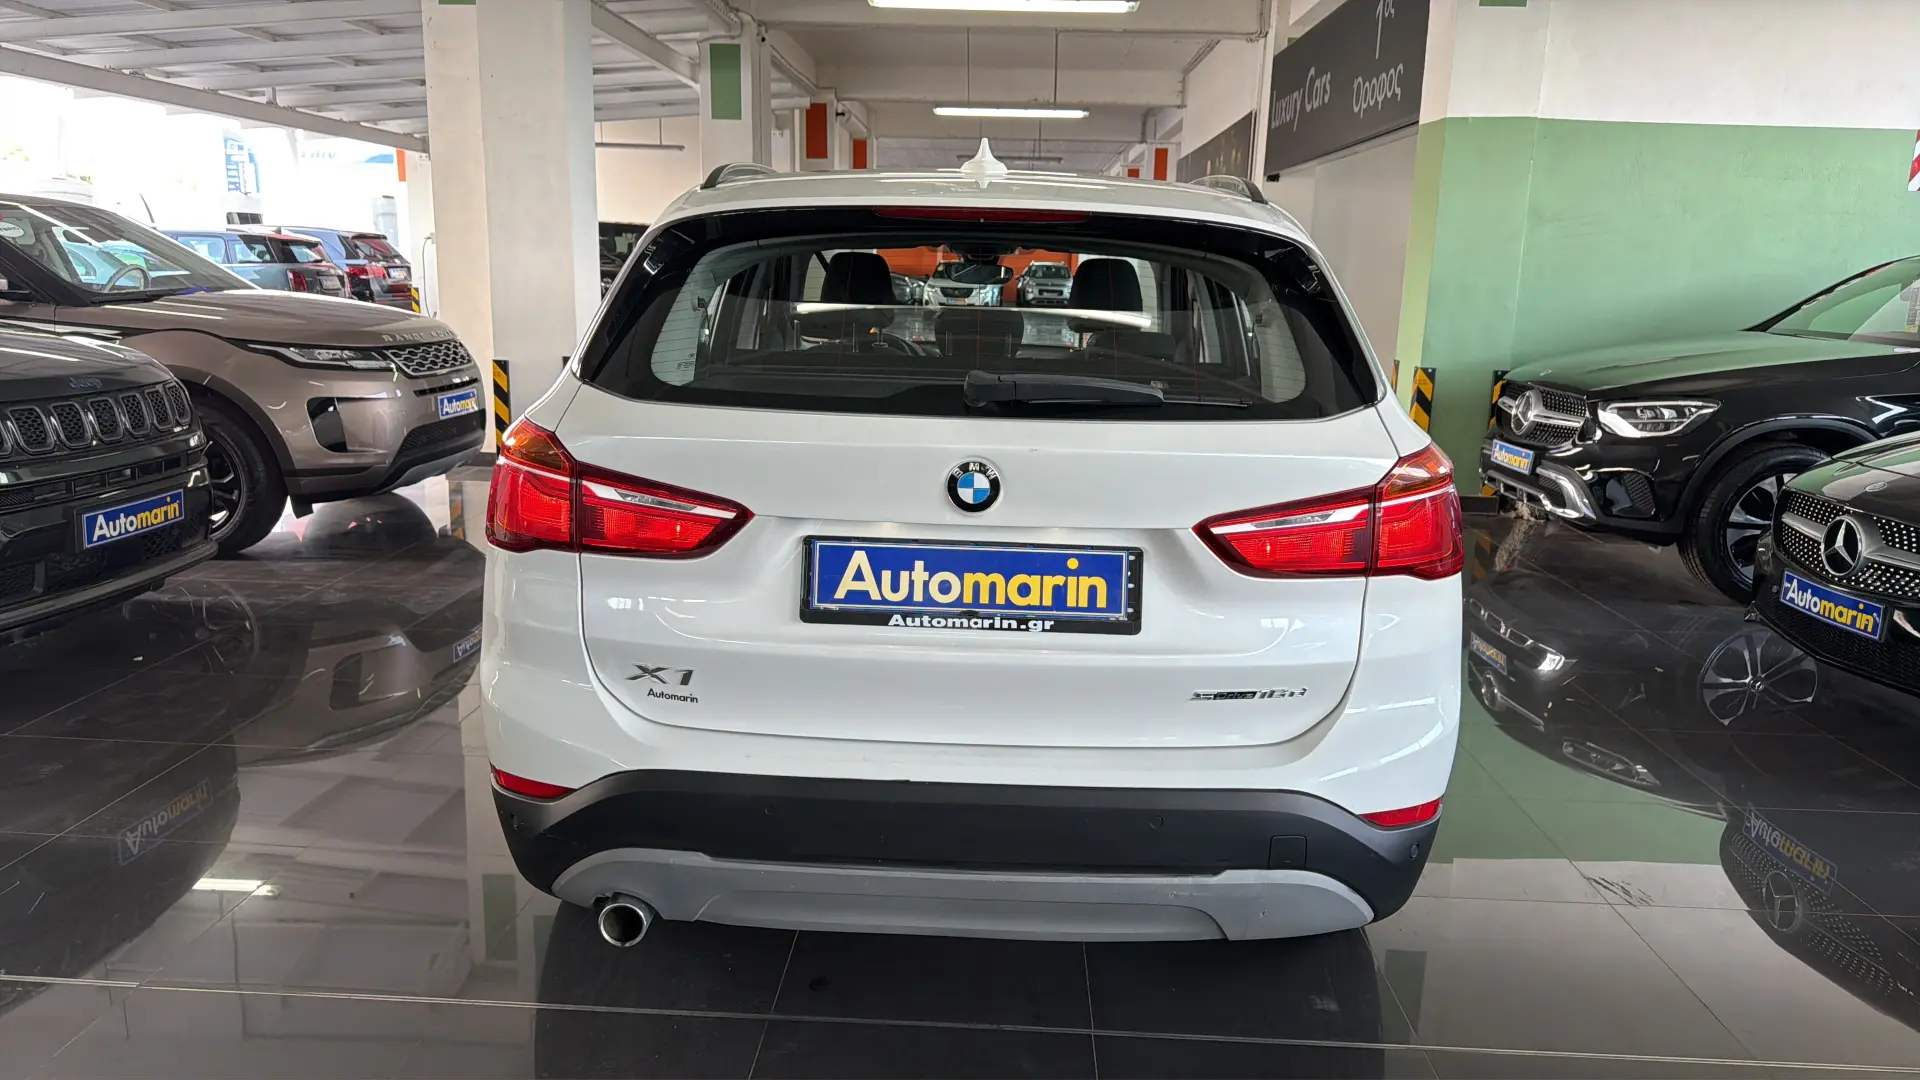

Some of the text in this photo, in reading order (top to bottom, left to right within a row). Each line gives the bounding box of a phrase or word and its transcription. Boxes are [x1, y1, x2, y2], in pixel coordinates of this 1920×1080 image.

[1271, 66, 1331, 132] Luxury Cars
[952, 462, 997, 480] BMW
[93, 496, 180, 542] Automarin
[833, 550, 1107, 609] Automarin
[1786, 578, 1875, 633] Automarin
[888, 614, 1055, 632] Automarin.gr
[625, 663, 694, 686] X1
[647, 688, 699, 704] Automarin
